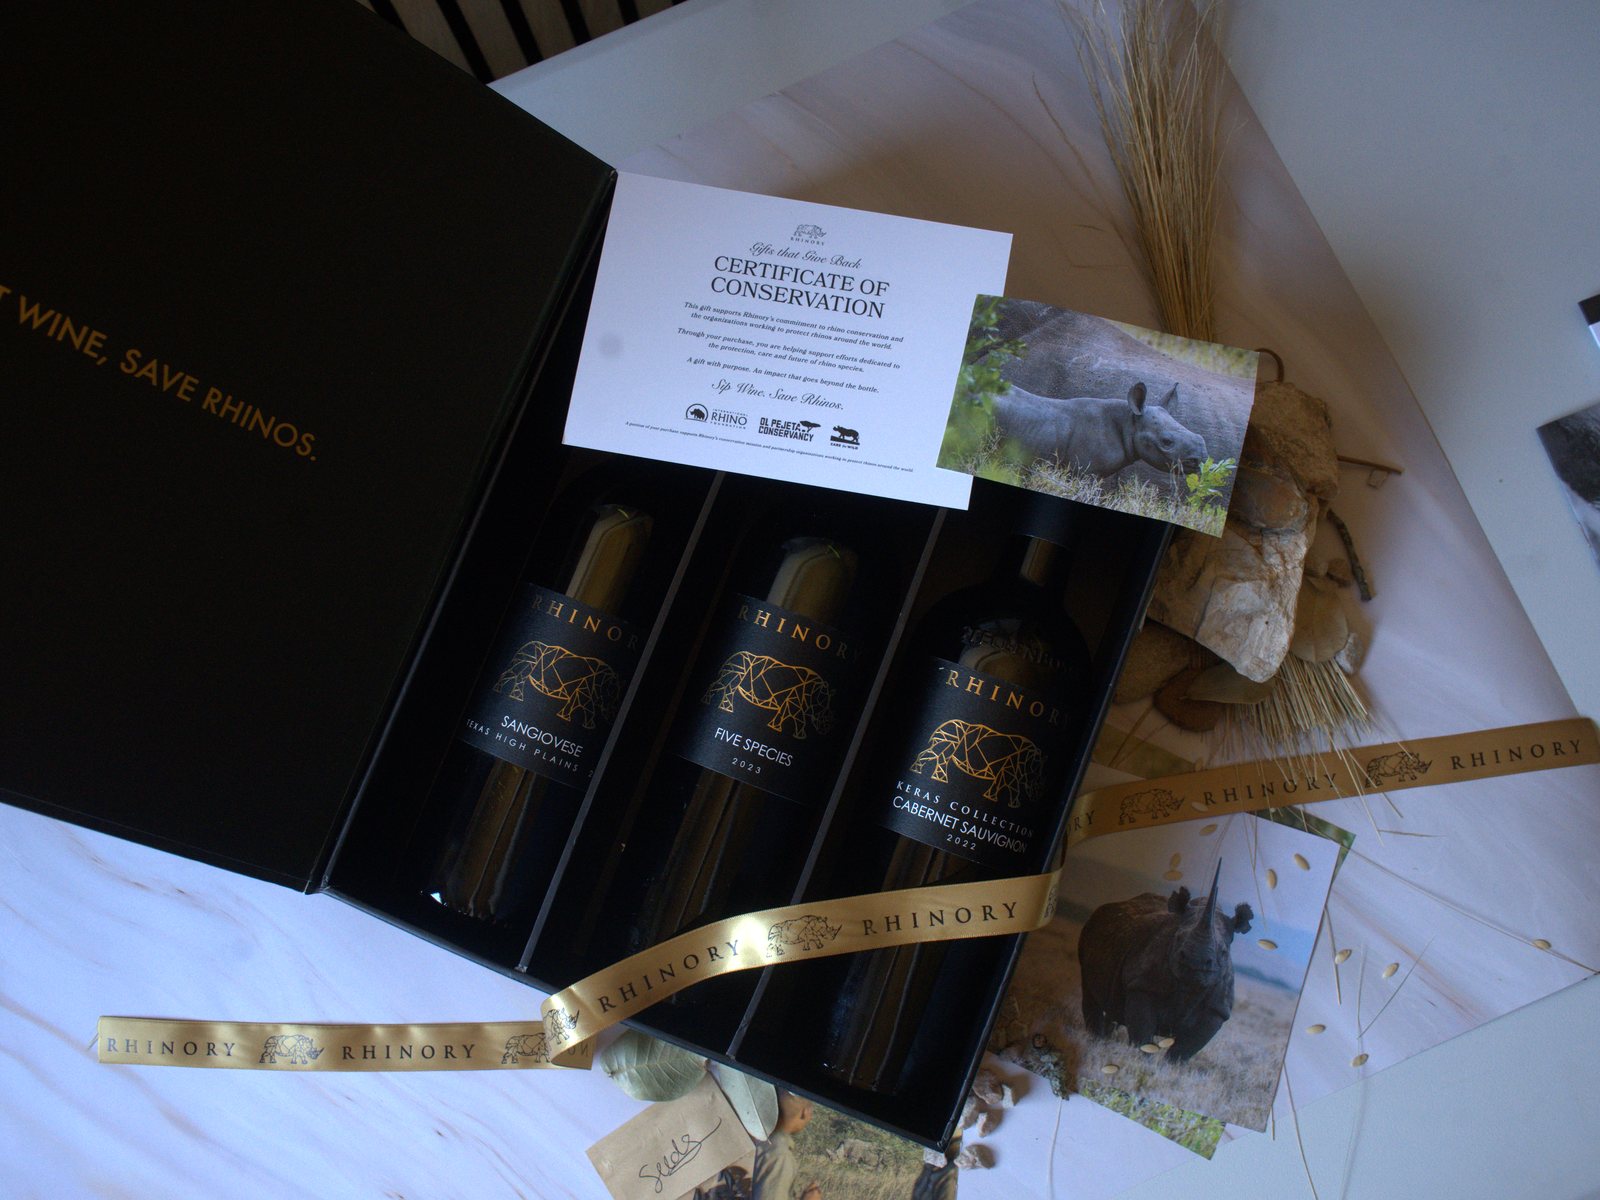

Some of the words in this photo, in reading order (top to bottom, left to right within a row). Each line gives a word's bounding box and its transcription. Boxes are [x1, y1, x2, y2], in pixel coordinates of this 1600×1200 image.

[749, 242, 775, 256] Gifts
[776, 247, 800, 258] that
[801, 251, 827, 263] Give
[829, 255, 862, 269] Back
[714, 256, 855, 292] CERTIFICATE
[860, 279, 890, 296] OF
[711, 276, 885, 318] CONSERVATION
[684, 301, 698, 309] This
[712, 308, 741, 316] supports
[775, 318, 817, 329] commitment
[826, 325, 845, 333] rhino
[846, 329, 889, 340] conservation
[703, 315, 748, 326] organizations
[749, 323, 776, 332] working
[810, 332, 832, 340] rhinos
[833, 336, 858, 344] around
[678, 327, 705, 338] Through
[722, 336, 754, 346] purchase,
[782, 345, 807, 355] helping
[808, 350, 834, 358] support
[835, 354, 857, 362] efforts
[859, 357, 892, 368] dedicated
[719, 345, 756, 355] protection,
[788, 355, 808, 363] future
[818, 360, 836, 368] rhino
[838, 364, 864, 372] species.
[18, 294, 108, 366] WINE,
[120, 348, 199, 402] SAVE
[202, 386, 317, 462] RHINOS.
[721, 363, 750, 372] purpose.
[763, 369, 787, 378] impact
[819, 378, 845, 387] beyond
[857, 384, 879, 393] bottle.
[711, 379, 731, 395] Sip
[737, 383, 765, 397] Wine.
[769, 388, 797, 402] Save
[800, 393, 843, 410] Rhinos.
[711, 412, 747, 426] RHINO
[758, 425, 814, 442] CONSERVANCY
[760, 417, 769, 426] OL
[771, 419, 802, 432] PEJETA
[531, 594, 639, 652] RHINOR
[466, 718, 491, 737] TEXAS
[495, 732, 527, 751] HIGH
[533, 748, 579, 773] PLAINS
[501, 715, 584, 758] SANGIOVESE
[714, 727, 742, 747] FIVE
[743, 738, 794, 768] SPECIES
[731, 757, 762, 774] 2023
[1450, 739, 1581, 770] RHINORY
[896, 780, 942, 805] KERAS
[1203, 772, 1337, 806] RHINORY
[892, 795, 960, 831] CABERNET
[960, 820, 1028, 854] SAUVIGNON
[946, 833, 977, 851] 2022
[862, 901, 1017, 938] RHINORY
[597, 938, 742, 1014] RHINORY
[105, 1037, 237, 1058] RHINORY
[342, 1043, 476, 1061] RHINORY
